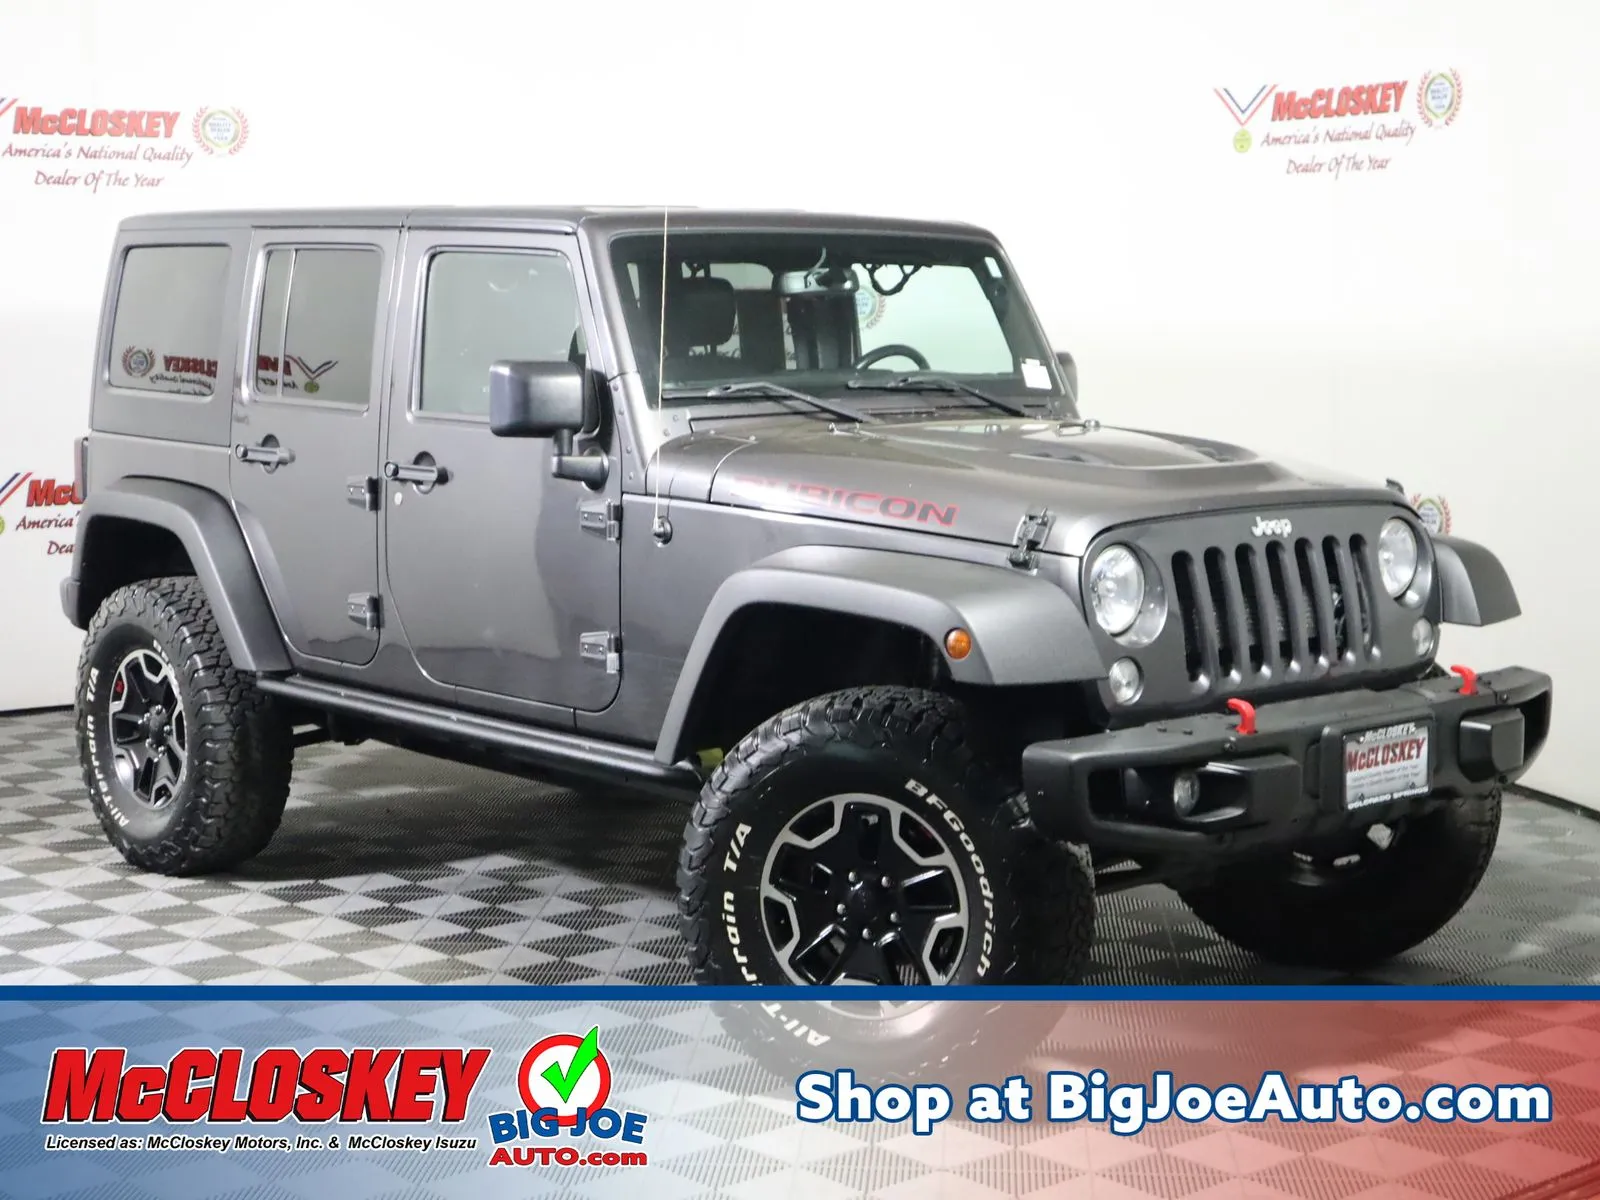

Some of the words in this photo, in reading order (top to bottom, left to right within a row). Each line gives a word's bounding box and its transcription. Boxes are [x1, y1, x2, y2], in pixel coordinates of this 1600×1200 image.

[1271, 80, 1408, 122] McCLOSKEY
[13, 106, 180, 138] McCLOSKEY
[1260, 126, 1320, 147] America's
[1323, 122, 1372, 143] National
[1376, 119, 1417, 146] Quality
[1, 141, 73, 159] America's
[77, 144, 140, 161] National
[143, 146, 194, 168] Quality
[1286, 155, 1326, 175] Dealer
[1328, 154, 1346, 181] Of
[1346, 152, 1364, 172] The
[1367, 155, 1392, 171] Year
[34, 169, 81, 187] Dealer
[84, 170, 104, 194] Of
[105, 170, 129, 187] The
[134, 173, 165, 188] Year
[15, 510, 81, 531] America'
[1251, 516, 1292, 538] Jeep
[723, 822, 752, 873] T/A
[904, 778, 996, 978] BFGoodrich
[721, 890, 832, 1047] All-Trrain
